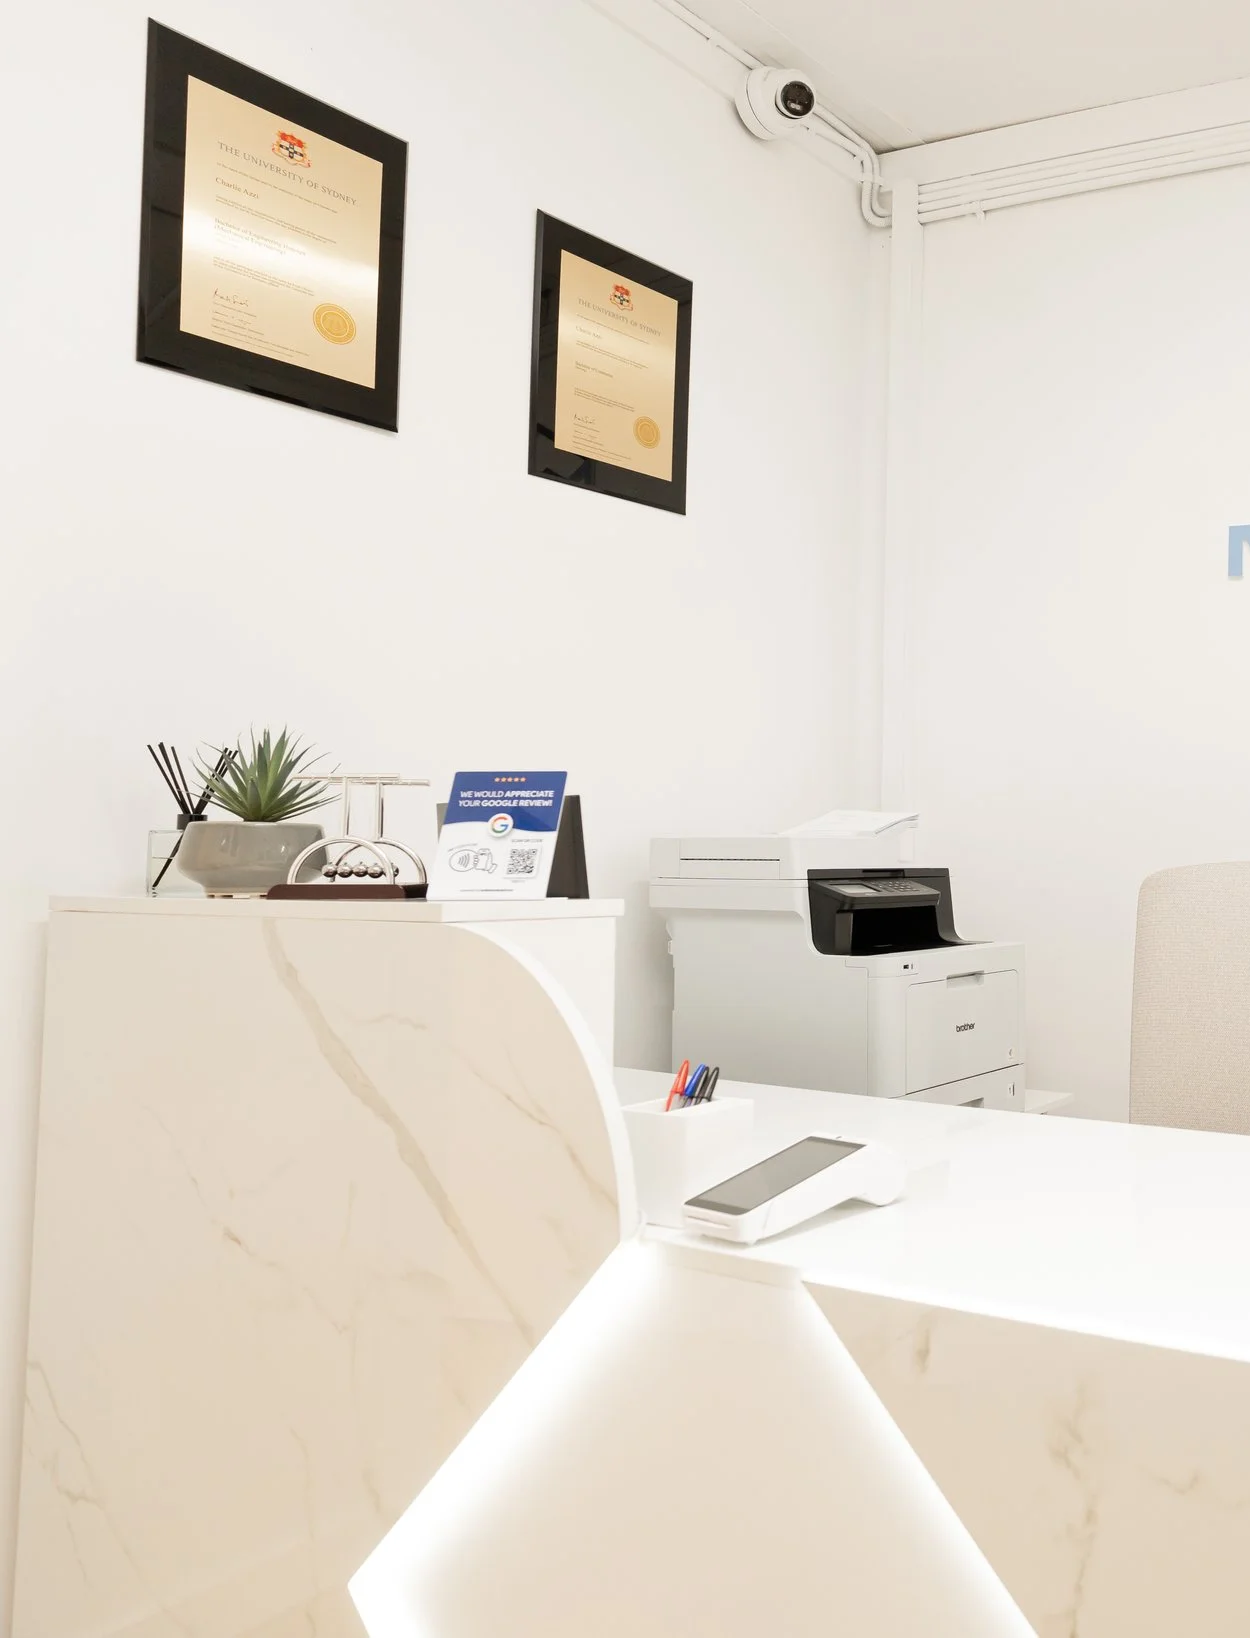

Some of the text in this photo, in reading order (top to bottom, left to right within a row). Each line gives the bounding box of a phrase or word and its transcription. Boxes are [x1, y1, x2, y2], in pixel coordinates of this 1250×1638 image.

[217, 141, 357, 206] THE UNIVERSITY OF SYDNEY
[215, 176, 241, 192] Charlie
[460, 790, 555, 798] WE WOULD APPRECIATE
[458, 799, 480, 807] YOUR
[481, 799, 520, 807] GOOGLE
[956, 1022, 976, 1033] brother
